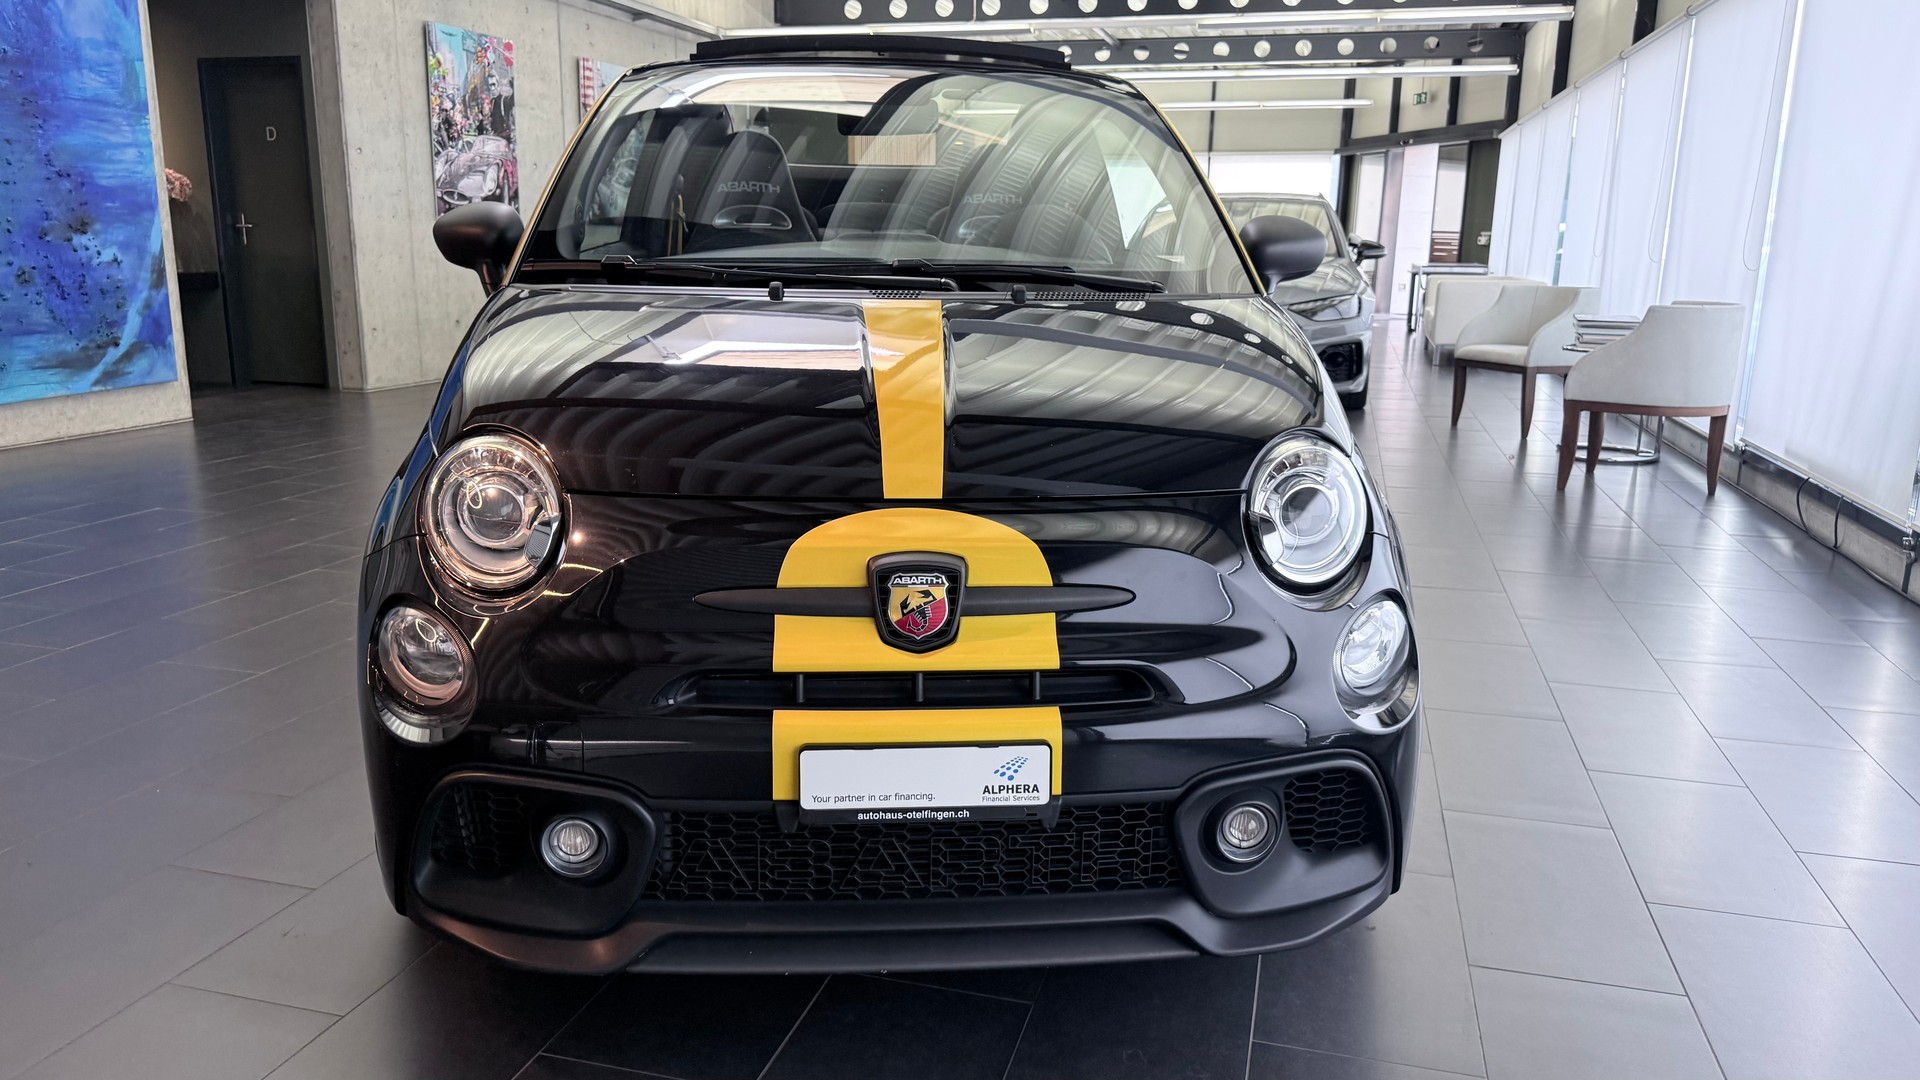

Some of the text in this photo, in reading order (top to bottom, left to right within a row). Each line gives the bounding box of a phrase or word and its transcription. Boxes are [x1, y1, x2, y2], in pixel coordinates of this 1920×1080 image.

[266, 126, 277, 141] D
[716, 181, 781, 194] ABARTH
[962, 193, 1023, 205] ABARTH
[893, 576, 942, 584] ABARTH
[982, 784, 1040, 795] ALPHERA
[812, 792, 936, 804] Your partner in car financing.
[857, 809, 970, 820] autohaus-otelfingen.ch
